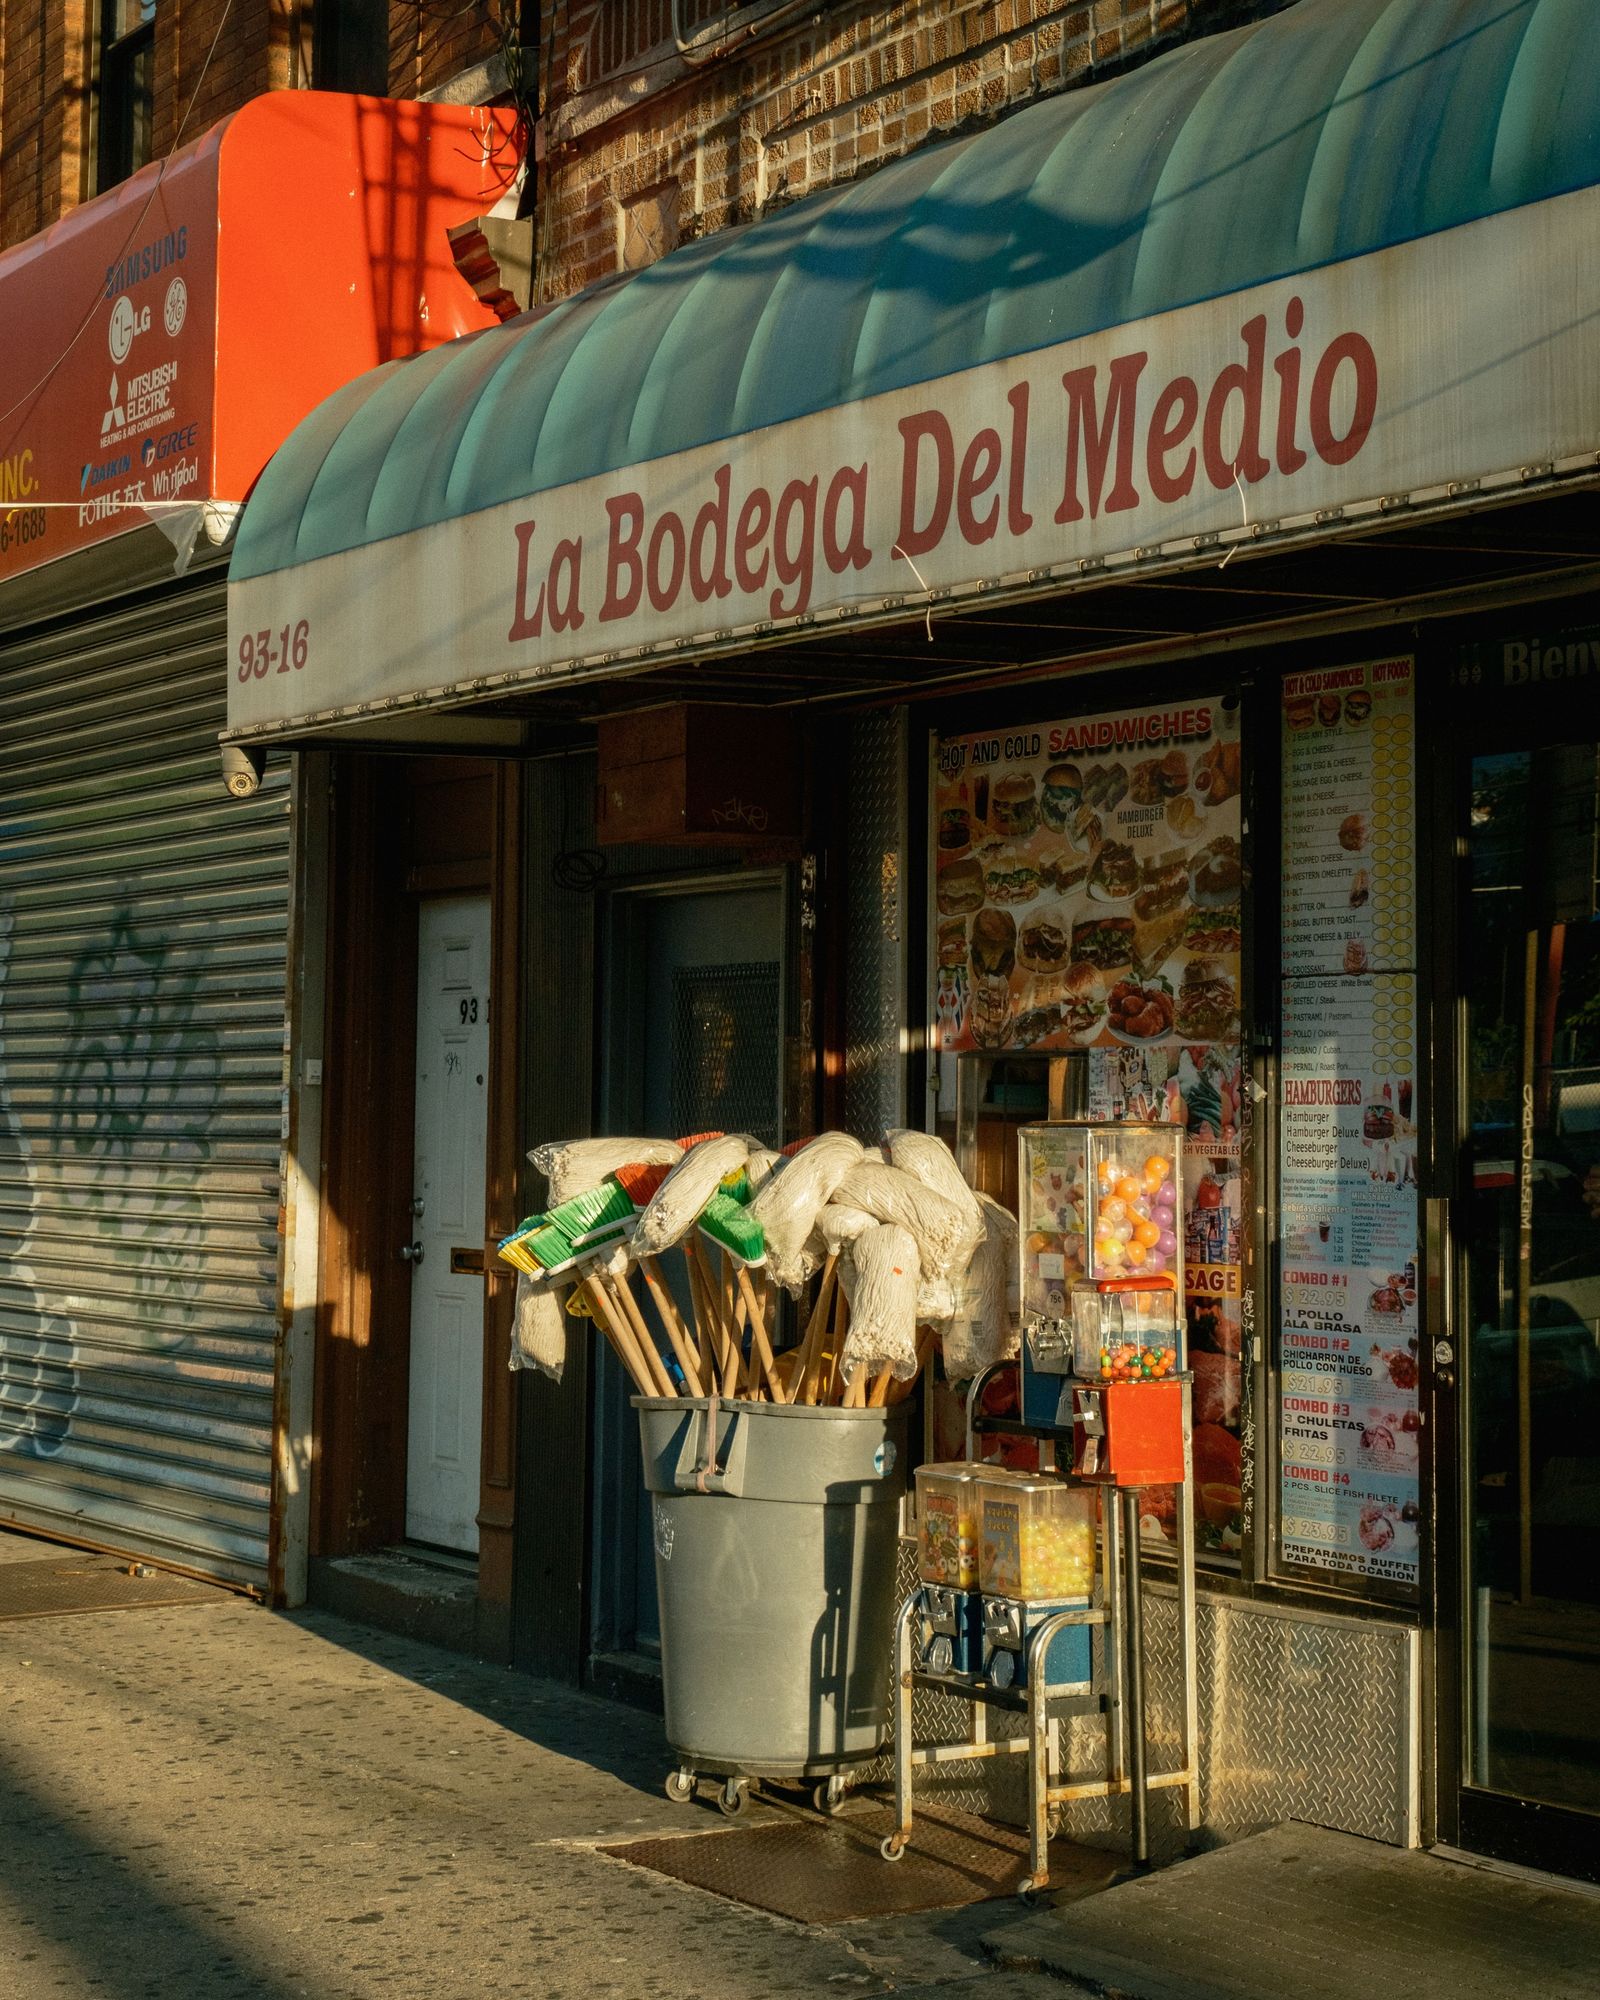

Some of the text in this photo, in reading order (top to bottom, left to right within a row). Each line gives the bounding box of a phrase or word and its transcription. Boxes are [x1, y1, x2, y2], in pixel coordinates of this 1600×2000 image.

[105, 225, 188, 299] SAMSUNG
[127, 360, 178, 397] MITSUBISHI
[127, 386, 170, 421] ELECTRIC
[100, 430, 122, 449] HEATING
[127, 424, 137, 439] AIR
[137, 408, 175, 435] CONDITIONING
[156, 421, 199, 460] GREE
[91, 453, 132, 487] DAIKIN
[508, 295, 1378, 643] La Bodega Del Medio
[152, 456, 199, 501] Whirlpool
[78, 488, 121, 528] FOTILE
[237, 618, 310, 684] 93-16
[941, 707, 1212, 770] HOT AND COLD SANDWICHES
[1333, 757, 1356, 767] CHEESE
[1292, 778, 1318, 788] SAUSAGE
[1320, 776, 1332, 785] EGG
[1340, 772, 1363, 782] CHEESE
[1312, 791, 1335, 800] CHEESE
[1117, 806, 1164, 825] HAMBURGER
[1326, 805, 1349, 814] CHEESE
[1127, 823, 1154, 840] DELUXE
[1292, 853, 1343, 865] CHOPPED CHEESE
[1321, 868, 1352, 878] OMELETTE
[1312, 915, 1356, 926] BUTTER TOAST
[1313, 933, 1336, 942] CHEESE
[1317, 980, 1337, 988] CHEESE
[1320, 996, 1335, 1004] Steak
[1318, 1029, 1339, 1038] Chicken
[1293, 1063, 1314, 1071] PERNIL
[1285, 1079, 1362, 1105] HAMBURGERS
[1287, 1111, 1329, 1124] Hamburger
[1287, 1126, 1359, 1140] Hamburger Deluxe
[1195, 1145, 1240, 1155] VEGETABLES
[1286, 1140, 1338, 1155] Cheeseburger
[1286, 1156, 1370, 1171] Cheeseburger Deluxe)
[1283, 1271, 1347, 1287] COMBO #1
[1299, 1289, 1346, 1307] 22.95
[1286, 1309, 1343, 1321] 1 POLLO
[1283, 1319, 1309, 1329] ALA
[1314, 1320, 1362, 1333] BRASA
[1283, 1334, 1350, 1351] COMBO #2
[1283, 1349, 1361, 1365] CHICHARRON DE
[1283, 1360, 1373, 1376] POLLO CON HUESO
[1288, 1373, 1343, 1395] $21.95
[1283, 1397, 1350, 1416] COMBO #3
[1297, 1415, 1365, 1431] CHULETAS
[1285, 1427, 1328, 1440] FRITAS
[1300, 1443, 1345, 1465] 22.95
[1283, 1465, 1350, 1485] COMBO #4
[1291, 1482, 1312, 1491] PCS.
[1315, 1485, 1341, 1496] SLICE
[1343, 1490, 1364, 1499] FISH
[1367, 1493, 1399, 1504] FILETE
[1300, 1521, 1347, 1542] 23.95
[1284, 1543, 1418, 1572] PREPARAMOS BUFFET
[1286, 1553, 1415, 1582] PARA TODA OCASION
